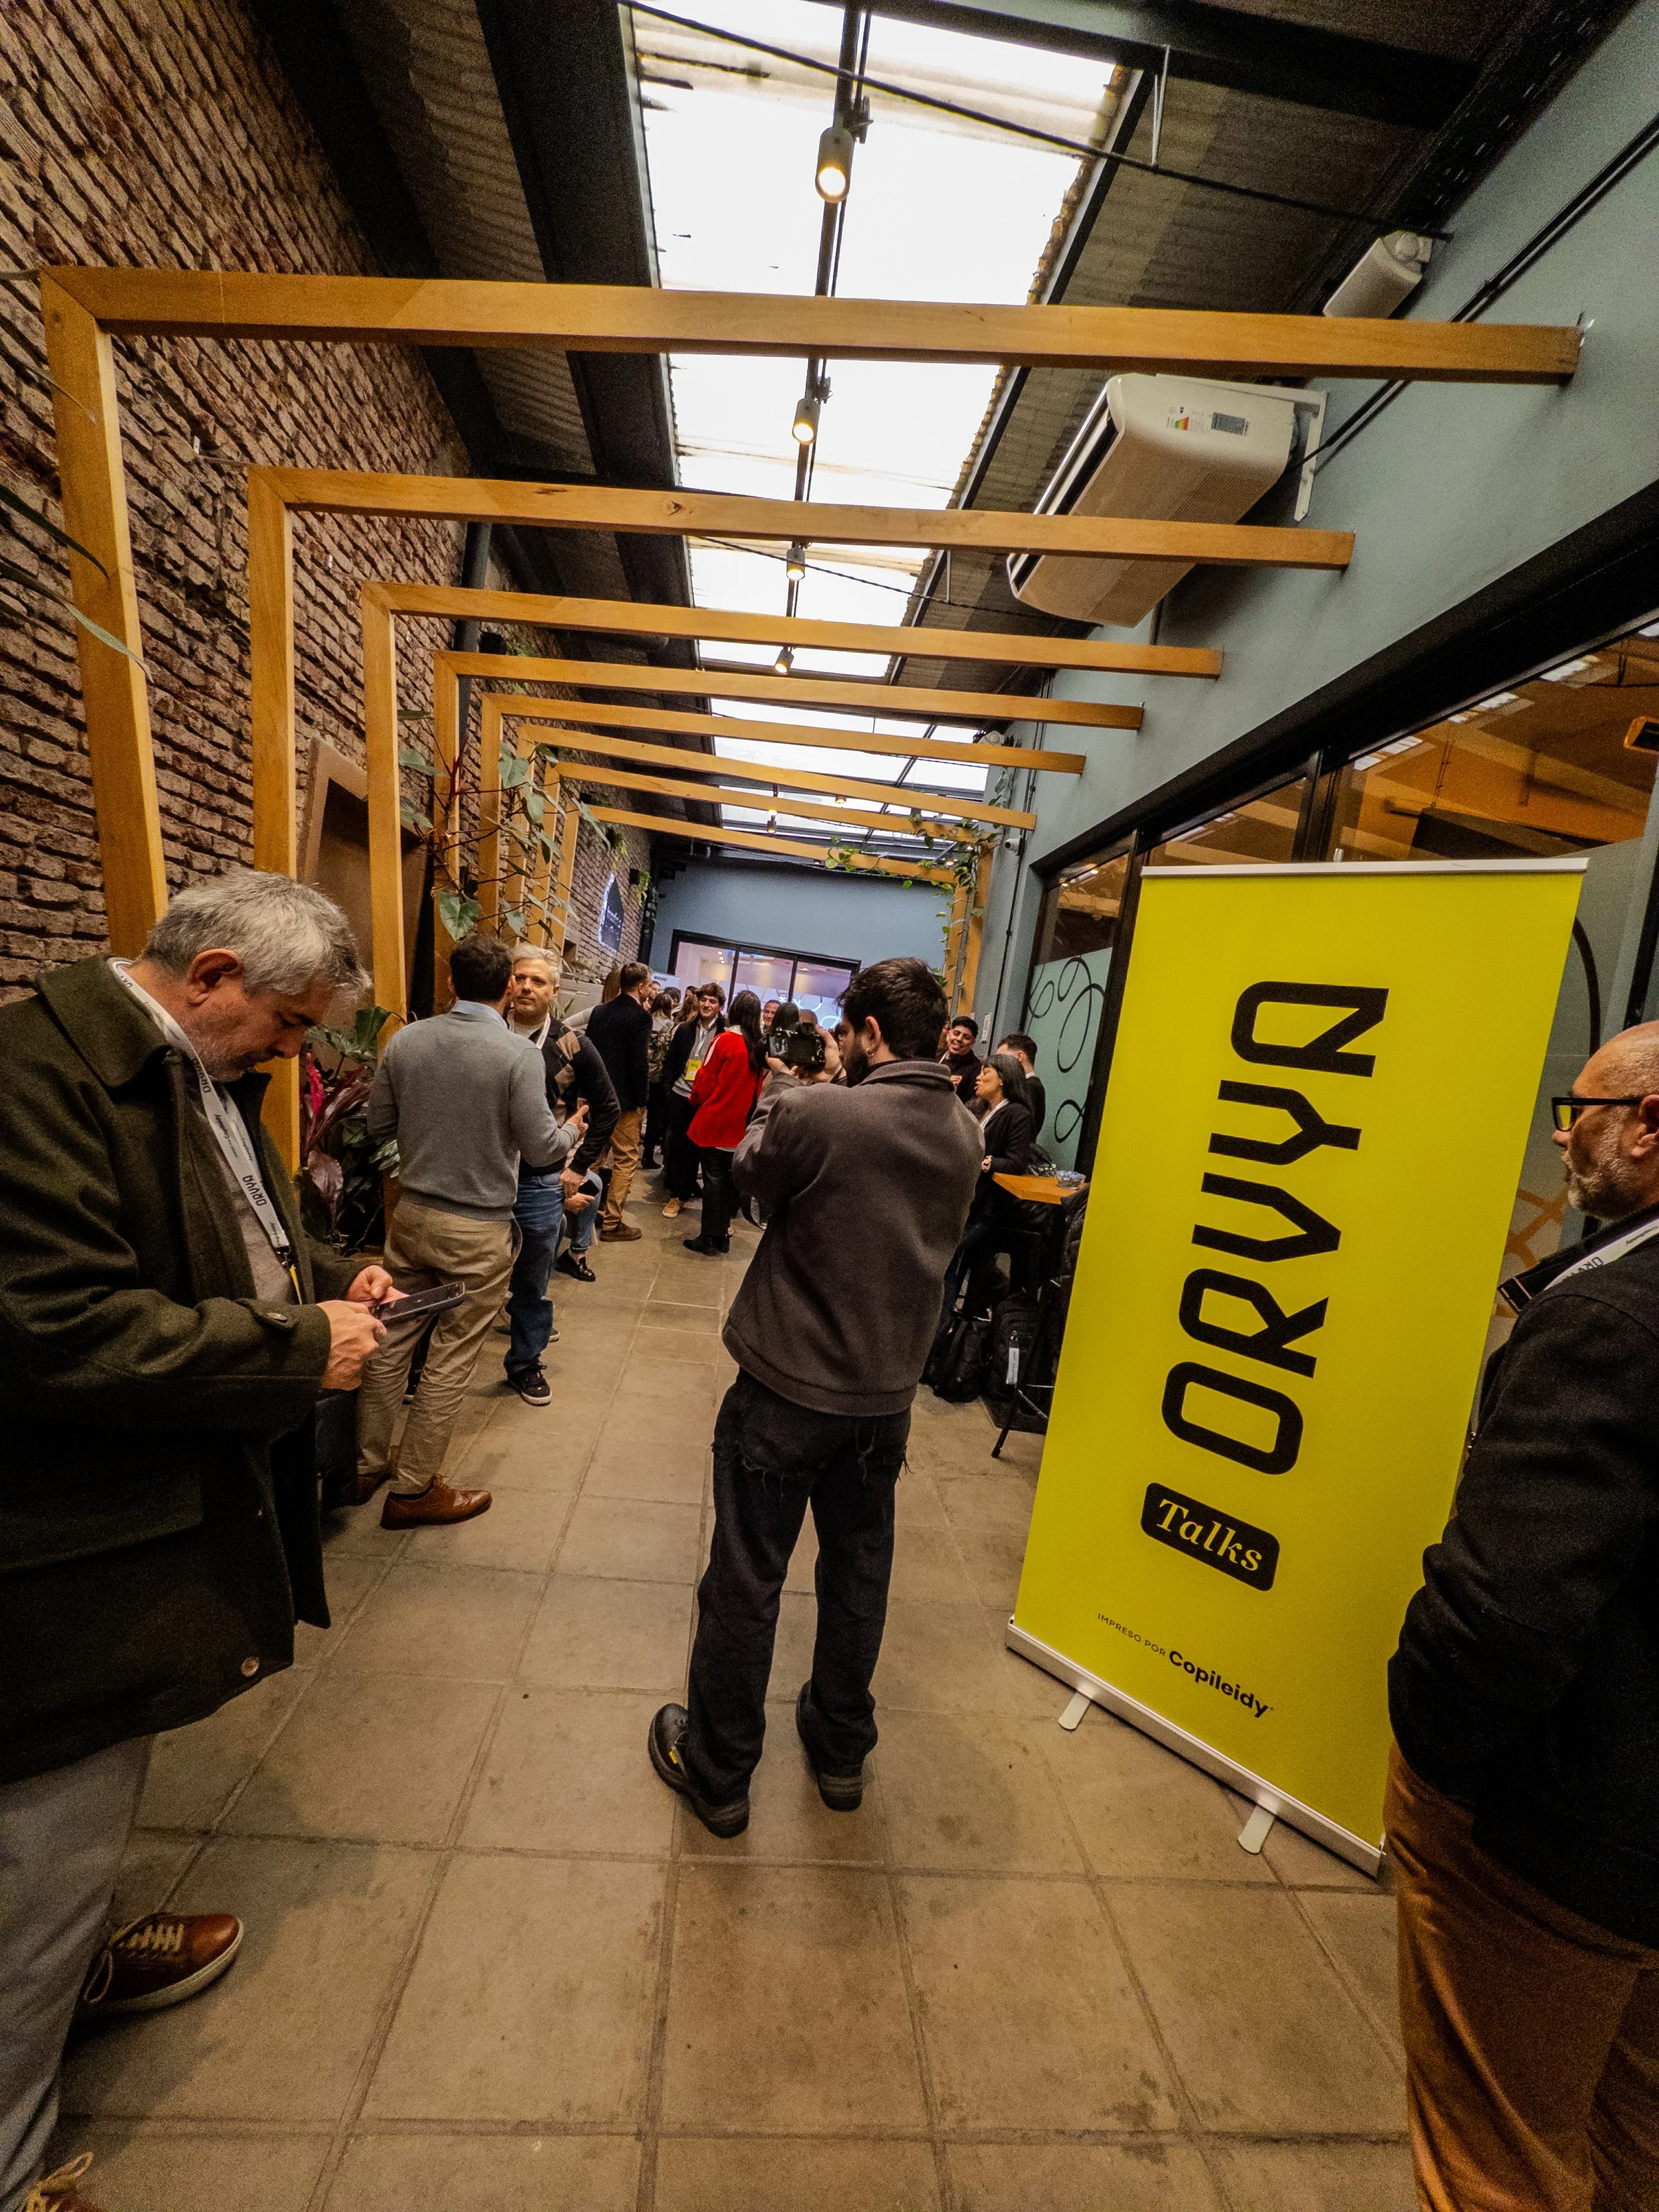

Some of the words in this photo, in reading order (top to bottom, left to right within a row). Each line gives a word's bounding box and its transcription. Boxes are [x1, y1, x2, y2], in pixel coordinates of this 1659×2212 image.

[242, 1175, 267, 1207] ORVYN
[1161, 981, 1389, 1475] ORVYN
[1156, 1499, 1262, 1572] Talks
[1098, 1613, 1141, 1643] IMPRESO
[1144, 1639, 1167, 1657] POR
[1169, 1650, 1270, 1718] Copileidy
